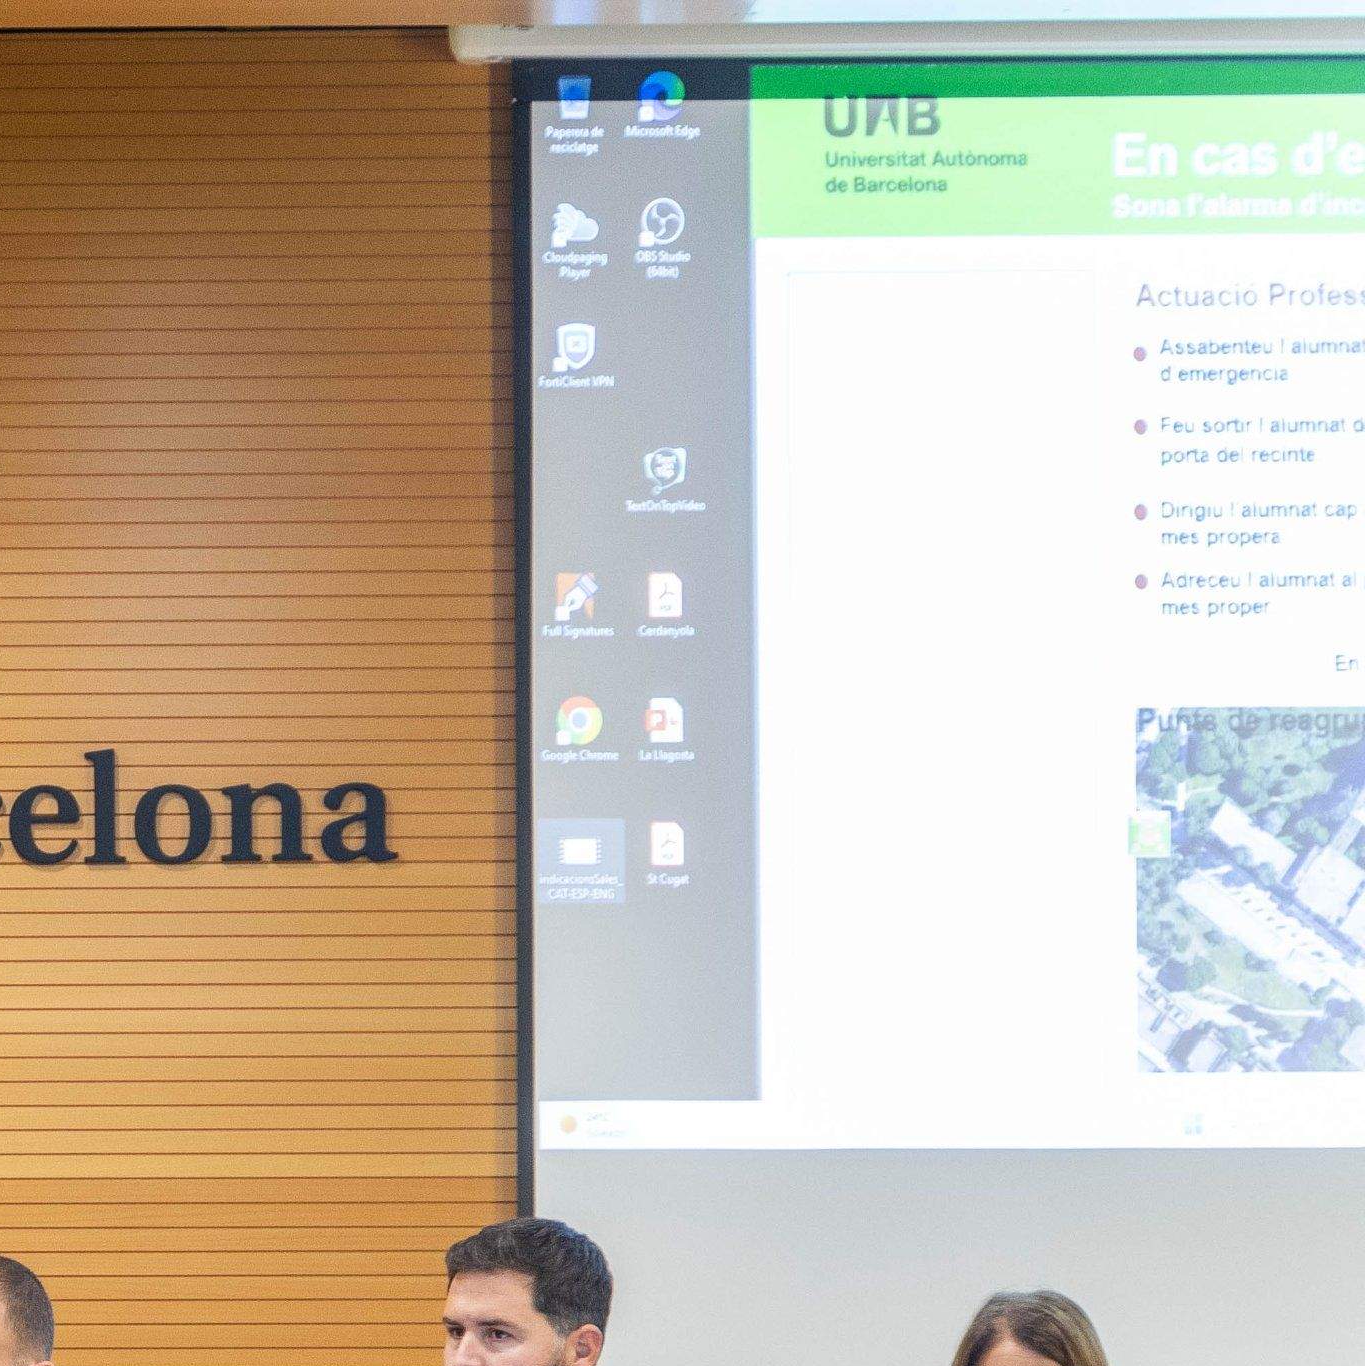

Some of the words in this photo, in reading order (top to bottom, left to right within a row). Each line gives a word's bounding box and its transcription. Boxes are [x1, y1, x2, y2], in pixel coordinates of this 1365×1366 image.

[822, 94, 941, 138] UAB
[624, 125, 674, 138] Microsoft
[674, 124, 701, 140] Edge
[825, 151, 926, 168] Universitat
[932, 150, 1029, 167] Autònoma
[1113, 131, 1178, 178] En
[1191, 140, 1279, 178] cas
[825, 176, 848, 193] de
[853, 176, 949, 193] Barcelona
[1112, 192, 1181, 219] Sona
[636, 250, 658, 263] OBS
[658, 250, 691, 263] Studio
[558, 266, 591, 281] Player
[1136, 280, 1258, 308] Actuació
[1160, 338, 1273, 355] Assabenteu
[1161, 416, 1195, 434] Feu
[1202, 415, 1257, 434] sortir
[1161, 447, 1210, 467] porta
[1217, 446, 1245, 463] del
[1250, 446, 1317, 463] recinte
[1161, 501, 1223, 523] Dirigiu
[1324, 503, 1359, 522] cap
[1207, 529, 1282, 550] propera
[1161, 571, 1241, 589] Adreceu
[1341, 571, 1358, 588] al
[1207, 600, 1271, 620] proper
[1335, 654, 1360, 672] En
[542, 750, 581, 765] Google
[580, 750, 620, 762] Chrome
